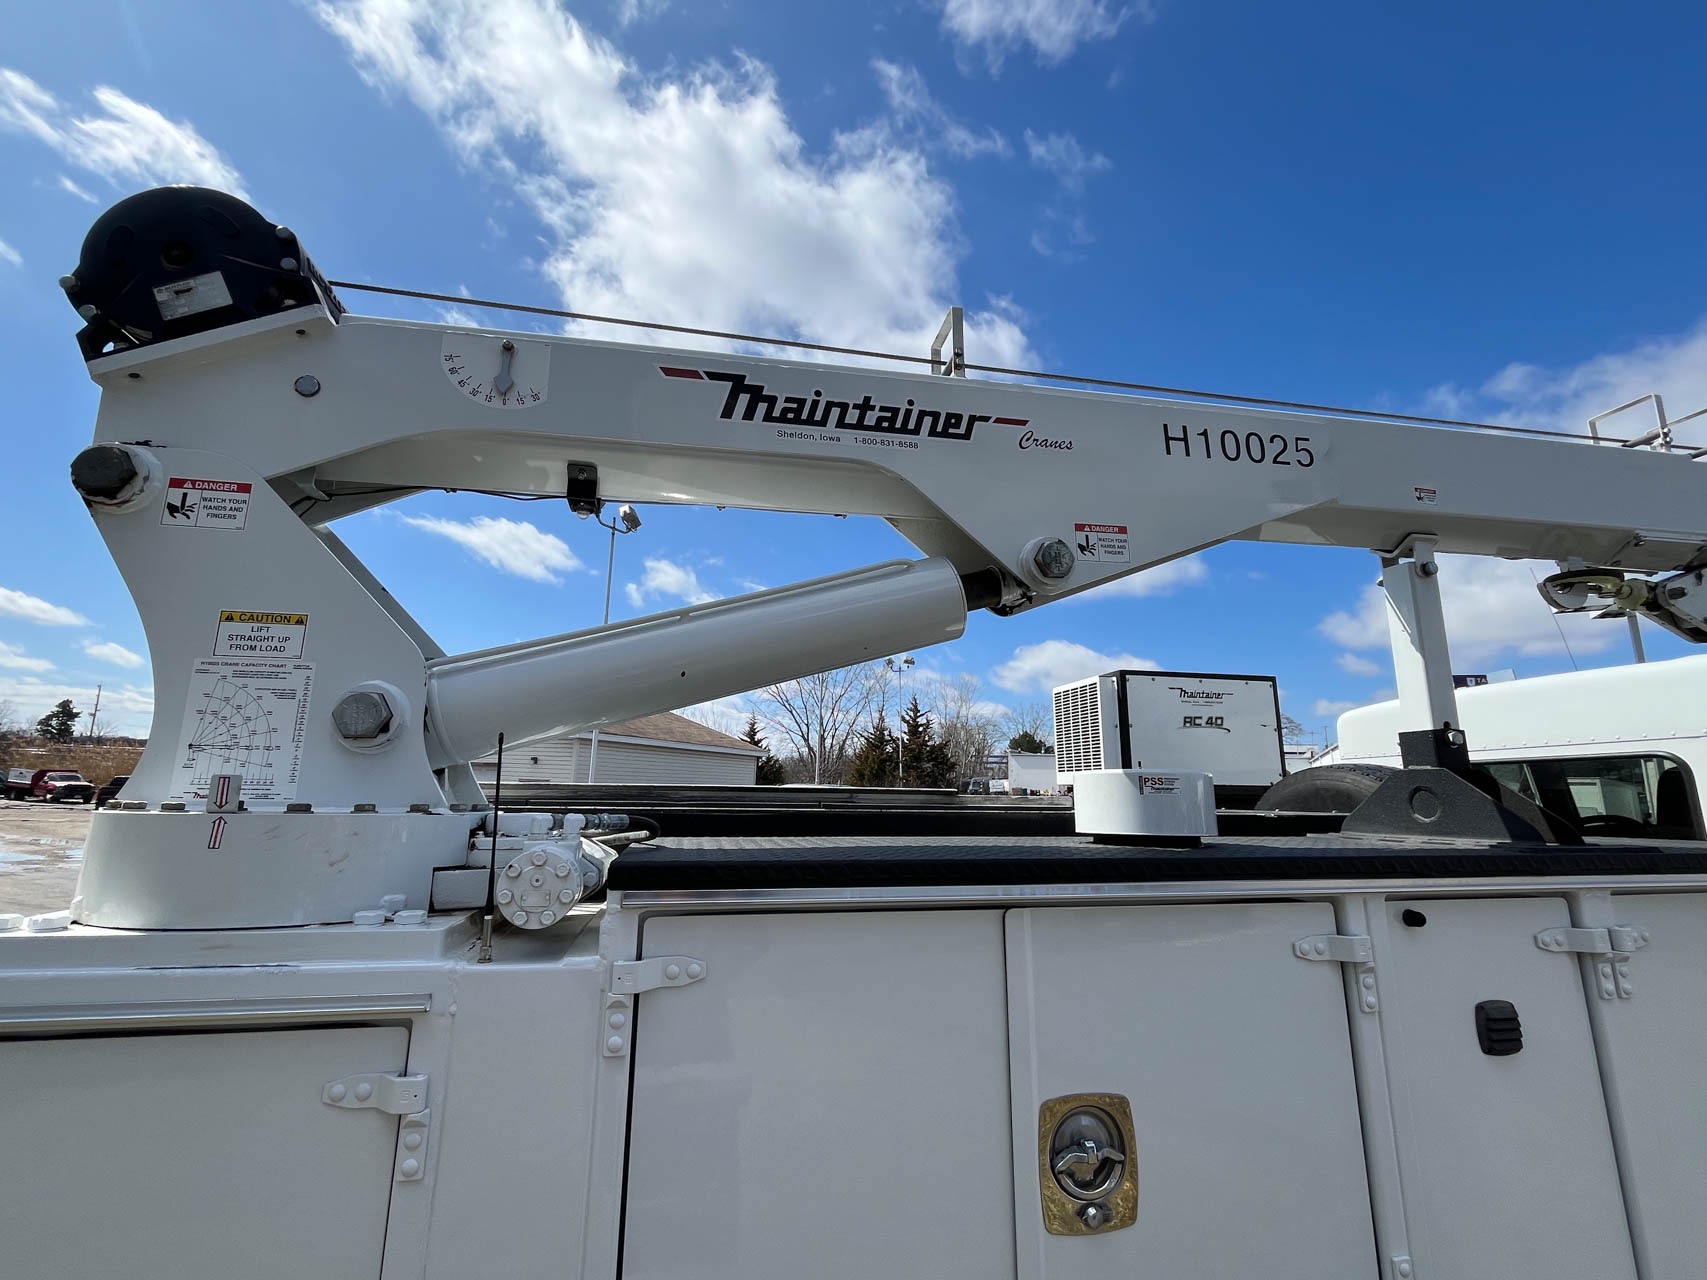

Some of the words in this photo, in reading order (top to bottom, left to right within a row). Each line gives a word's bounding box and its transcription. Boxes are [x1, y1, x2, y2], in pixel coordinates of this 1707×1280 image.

[703, 370, 994, 441] Maintainer
[777, 430, 818, 441] Sheldon,
[820, 433, 841, 442] Iowa
[1019, 430, 1075, 450] Cranes
[854, 437, 919, 449] 1-800-831-8588
[1162, 423, 1314, 467] H10025
[195, 481, 238, 491] DANGER
[202, 496, 227, 504] WATCH
[1091, 525, 1119, 533] DANGER
[239, 614, 292, 623] CAUTION
[228, 634, 276, 642] STRAIGHT
[229, 643, 257, 651] FROM
[1176, 687, 1227, 699] Maintainer
[1206, 716, 1224, 726] 40
[1143, 777, 1164, 786] PSS
